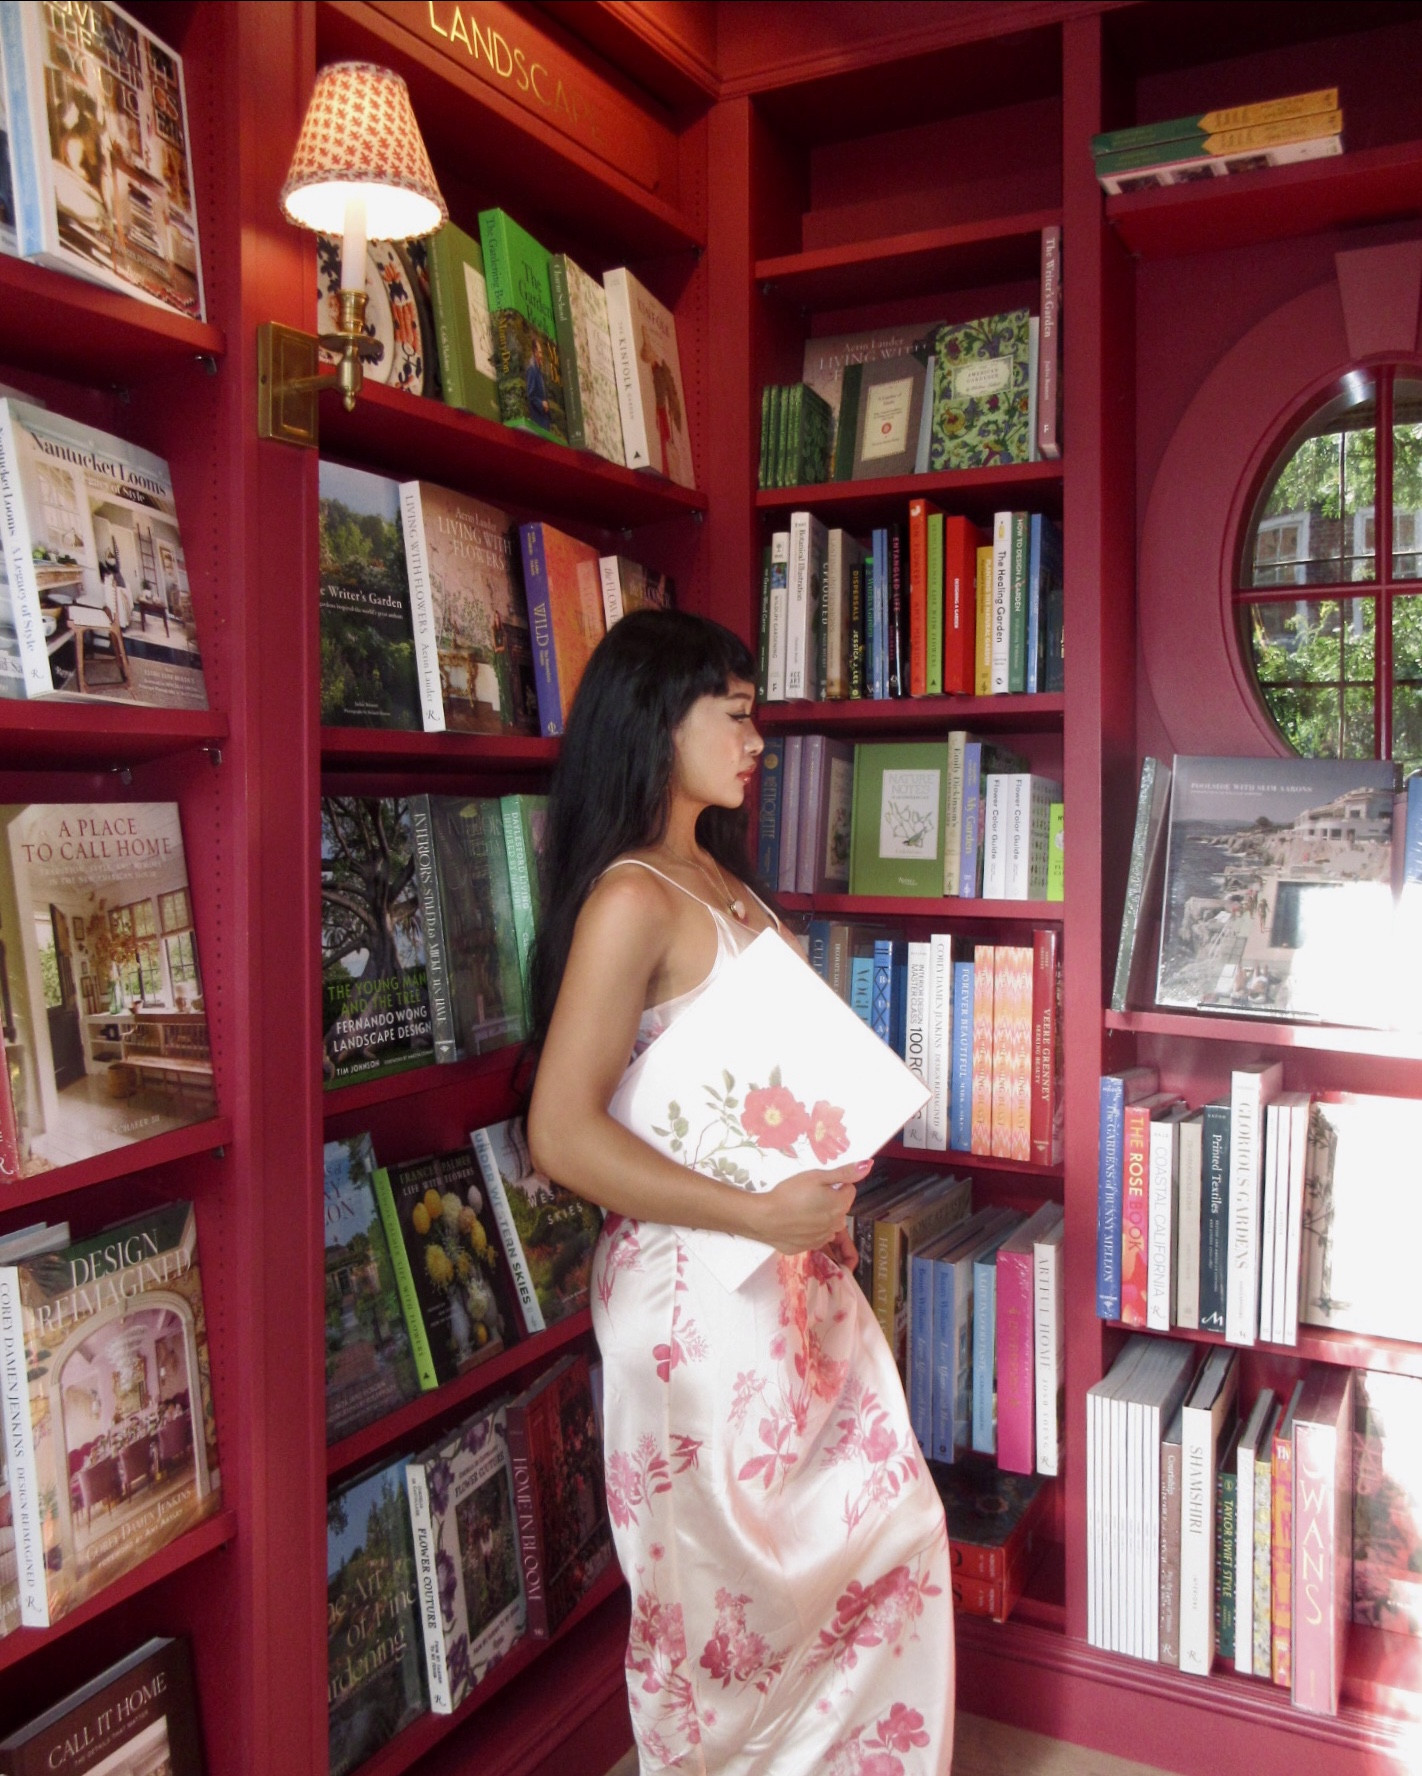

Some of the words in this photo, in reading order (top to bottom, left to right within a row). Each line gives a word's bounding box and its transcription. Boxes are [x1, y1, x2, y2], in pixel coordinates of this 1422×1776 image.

[1045, 237, 1057, 258] The
[1043, 300, 1055, 338] Garden
[619, 338, 631, 391] KINFOLK
[819, 351, 876, 371] LIVING
[31, 431, 116, 478] Nantucket
[118, 462, 167, 497] Looms
[4, 494, 15, 536] Looms
[404, 495, 416, 540] LIVING
[1016, 518, 1024, 537] HOW
[438, 516, 482, 545] LIVING
[483, 530, 513, 556] WITH
[453, 539, 505, 571] FLOWERS
[410, 541, 422, 577] WITH
[997, 550, 1007, 567] The
[328, 584, 366, 604] Writer's
[369, 592, 404, 609] Garden
[414, 578, 429, 635] FLOWERS
[994, 569, 1006, 605] Healing
[534, 602, 550, 647] WILD
[995, 606, 1006, 643] Garden
[965, 797, 977, 812] My
[993, 779, 1001, 808] Flower
[1014, 779, 1023, 808] Flower
[58, 820, 72, 838] A
[77, 818, 138, 837] PLACE
[964, 816, 977, 855] Garden
[992, 809, 1000, 834] Color
[1013, 809, 1022, 834] Color
[22, 843, 53, 863] TO
[60, 841, 111, 861] CALL
[117, 837, 172, 857] HOME
[414, 813, 433, 886] INTERIORS
[990, 834, 999, 860] Guide
[1012, 834, 1021, 860] Guide
[935, 943, 945, 974] COREY
[328, 984, 352, 1002] THE
[356, 976, 400, 996] YOUNG
[403, 971, 428, 987] MAN
[341, 998, 368, 1016] AND
[373, 993, 394, 1009] THE
[396, 989, 421, 1006] TREE
[961, 968, 970, 1016] FOREVER
[333, 1028, 395, 1053] LANDSCAPE
[397, 1021, 433, 1039] DESIGN
[336, 1011, 395, 1035] FERNANDO
[395, 1005, 428, 1022] WONG
[933, 1010, 944, 1048] JENKINS
[1041, 1009, 1051, 1046] VEERE
[908, 1027, 923, 1054] 100
[959, 1018, 968, 1078] BEAUTIFUL
[336, 1066, 349, 1077] TIM
[350, 1059, 381, 1074] JOHNSON
[1040, 1048, 1051, 1102] GRENNEY
[1105, 1123, 1117, 1178] GARDENS
[1128, 1117, 1145, 1147] THE
[1236, 1102, 1252, 1187] GLORIOUS
[1211, 1134, 1223, 1171] Printed
[402, 1183, 420, 1197] LIFE
[423, 1176, 443, 1190] WITH
[1128, 1152, 1145, 1197] ROSE
[1154, 1146, 1168, 1209] COASTAL
[1210, 1174, 1222, 1214] Textiles
[475, 1133, 494, 1183] UNDER
[512, 1262, 532, 1304] SKIES
[547, 1202, 584, 1225] SKIES
[1104, 1192, 1116, 1231] BUNNY
[1127, 1201, 1144, 1251] BOOK
[1234, 1191, 1250, 1269] GARDENS
[70, 1228, 159, 1288] DESIGN
[875, 1236, 888, 1280] HOME
[1102, 1232, 1115, 1282] MELLON
[1152, 1214, 1167, 1297] CALIFORNIA
[38, 1248, 192, 1337] REIMAGINED
[875, 1283, 887, 1303] AT
[1038, 1256, 1050, 1312] ARTFUL
[1, 1282, 14, 1332] COREY
[4, 1337, 19, 1392] DAMEN
[1038, 1323, 1051, 1370] HOME
[7, 1394, 24, 1458] JENKINS
[16, 1467, 28, 1510] DESIGN
[455, 1469, 480, 1498] FLOWER
[512, 1457, 533, 1510] HOME
[1167, 1455, 1177, 1496] Courtship
[1190, 1444, 1203, 1535] SHAMSHIRI
[519, 1513, 536, 1533] IN
[1223, 1500, 1234, 1536] TAYLOR
[20, 1512, 36, 1588] REIMAGINED
[417, 1527, 432, 1574] FLOWER
[522, 1534, 543, 1602] BLOOM
[1222, 1538, 1234, 1567] SWIFT
[423, 1576, 438, 1631] COUTURE
[1222, 1569, 1234, 1599] STYLE
[48, 1726, 95, 1769] CALL
[97, 1709, 113, 1736] IT
[116, 1672, 168, 1723] HOME
